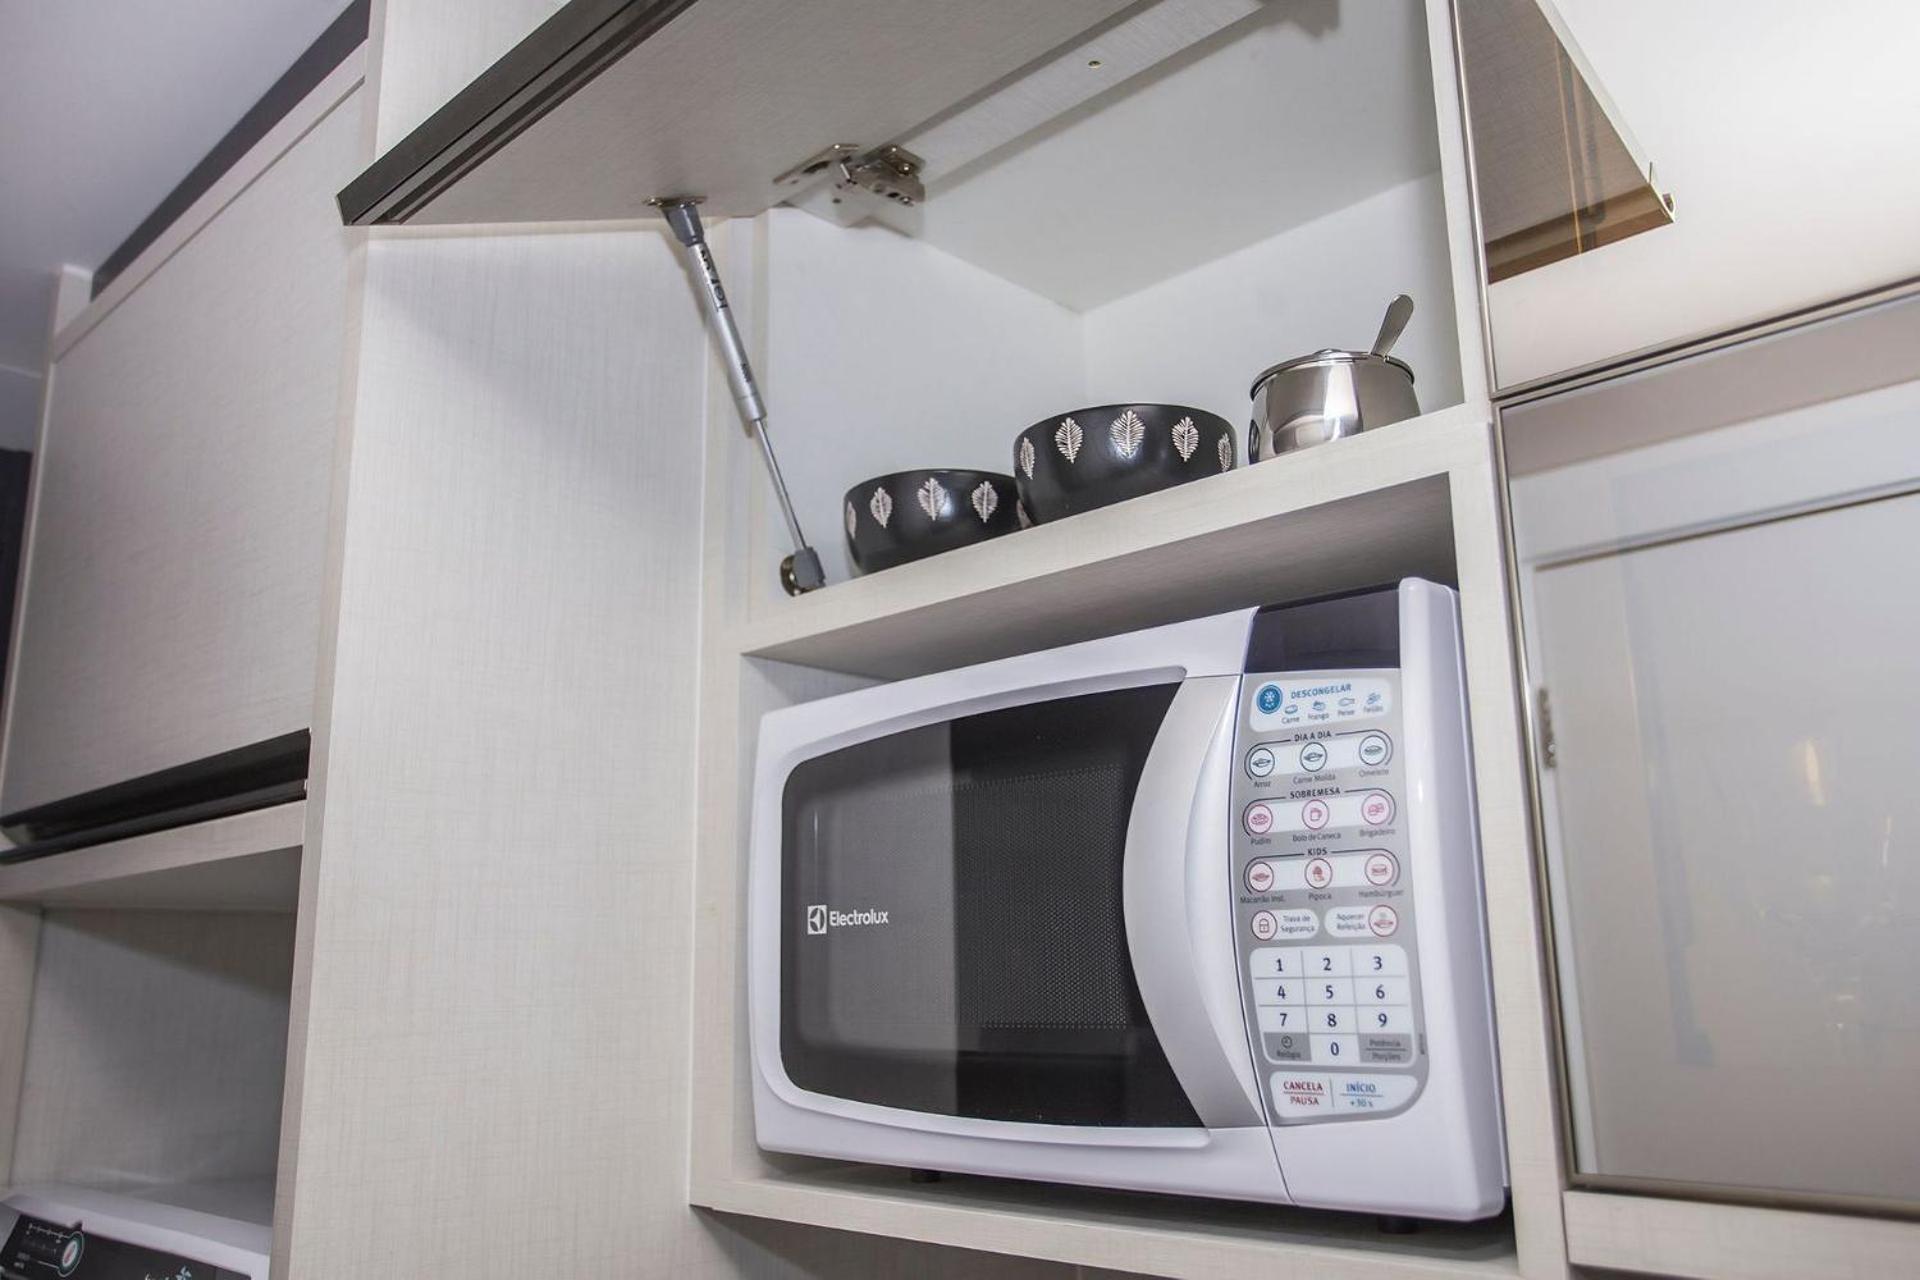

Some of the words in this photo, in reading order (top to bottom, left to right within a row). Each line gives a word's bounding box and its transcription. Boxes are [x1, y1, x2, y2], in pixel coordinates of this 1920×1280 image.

[1291, 684, 1352, 699] DESCONGELAR
[1282, 716, 1300, 724] Carne
[1294, 734, 1308, 742] DIA
[1293, 776, 1312, 785] Carne
[1290, 787, 1340, 799] SOBREMESA
[1251, 837, 1271, 846] Pudim
[1292, 834, 1307, 842] Bolo
[1308, 833, 1316, 841] de
[1316, 832, 1341, 840] Caneca
[1308, 847, 1328, 856] KIDS
[1308, 893, 1332, 901] Pipoca
[829, 908, 888, 926] Electrolux
[1276, 958, 1283, 972] 1
[1323, 957, 1332, 971] 2
[1374, 956, 1382, 970] 3
[1277, 985, 1286, 999] 4
[1326, 985, 1334, 999] 5
[1376, 985, 1385, 999] 6
[1280, 1013, 1288, 1026] 7
[1327, 1014, 1337, 1027] 8
[1378, 1014, 1387, 1027] 9
[1330, 1042, 1340, 1056] 0
[1284, 1081, 1322, 1091] CANCELA
[1346, 1082, 1376, 1092] INÍCIO
[1290, 1096, 1320, 1106] PAUSA
